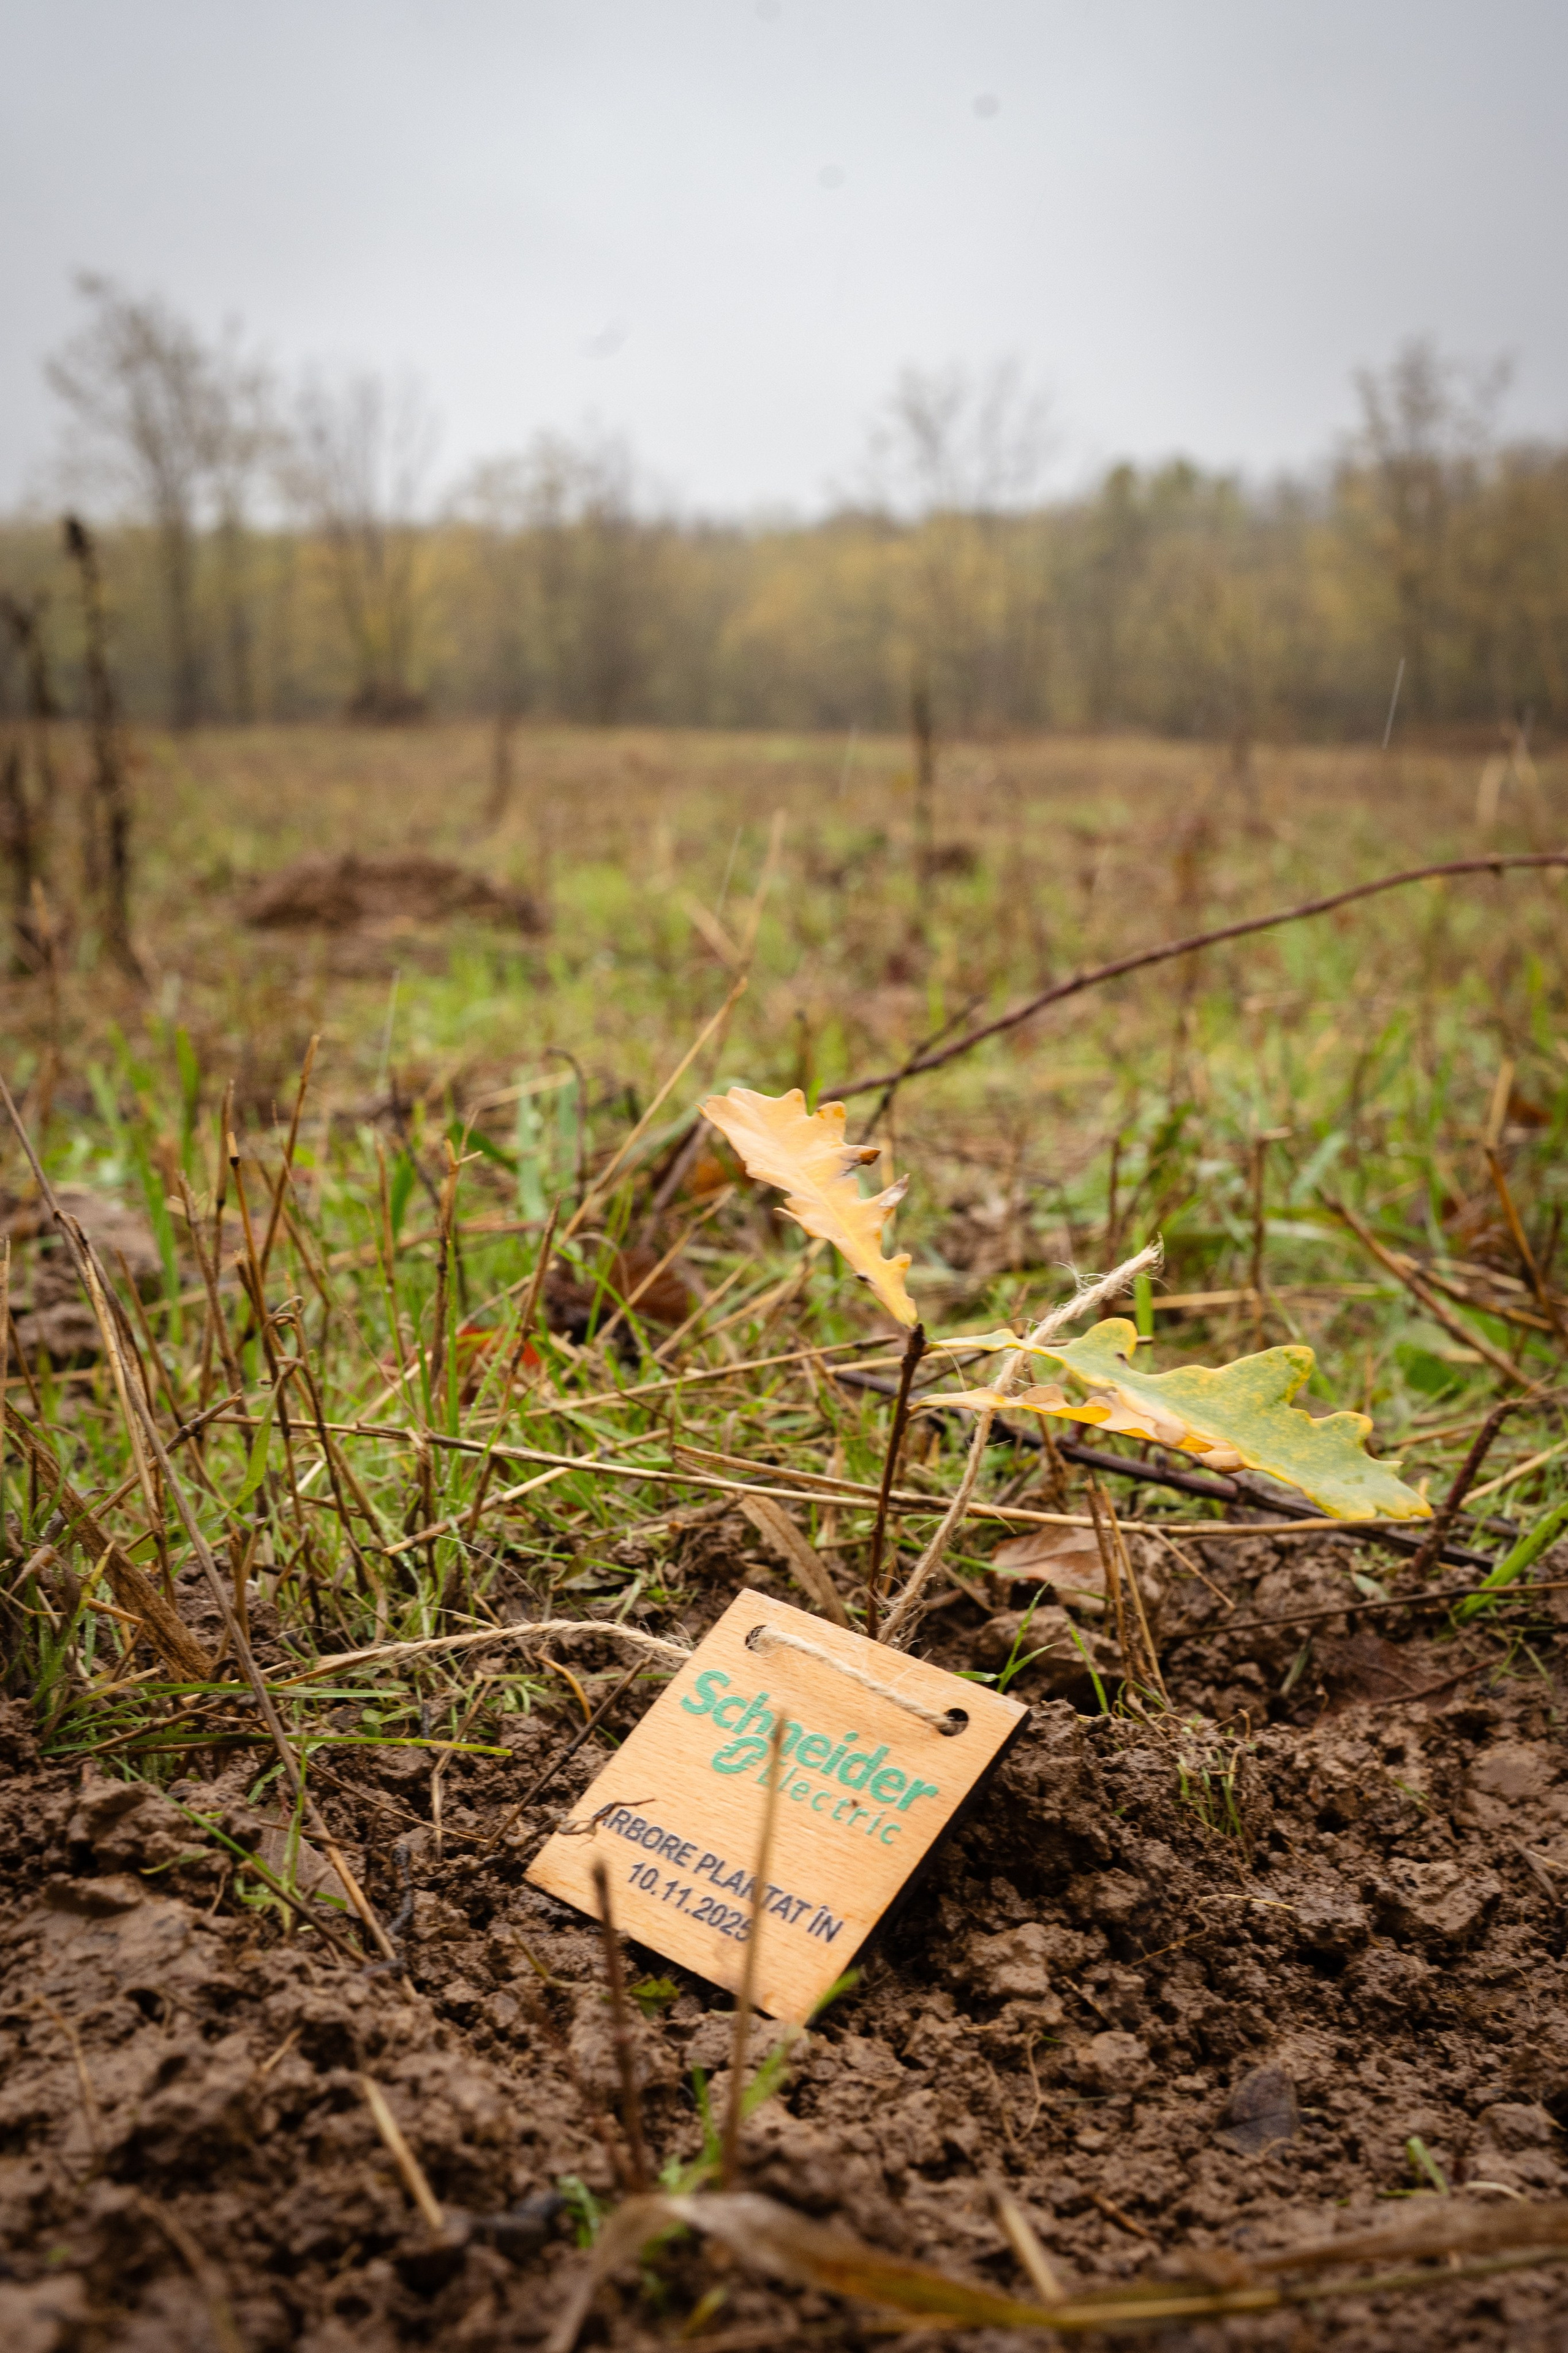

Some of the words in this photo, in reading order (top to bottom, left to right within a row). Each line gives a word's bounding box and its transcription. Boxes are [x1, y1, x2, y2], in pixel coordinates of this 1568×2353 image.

[680, 1669, 939, 1811] Schneider
[627, 1861, 757, 1943] 10.11.2025
[806, 1905, 844, 1943] ÎN
